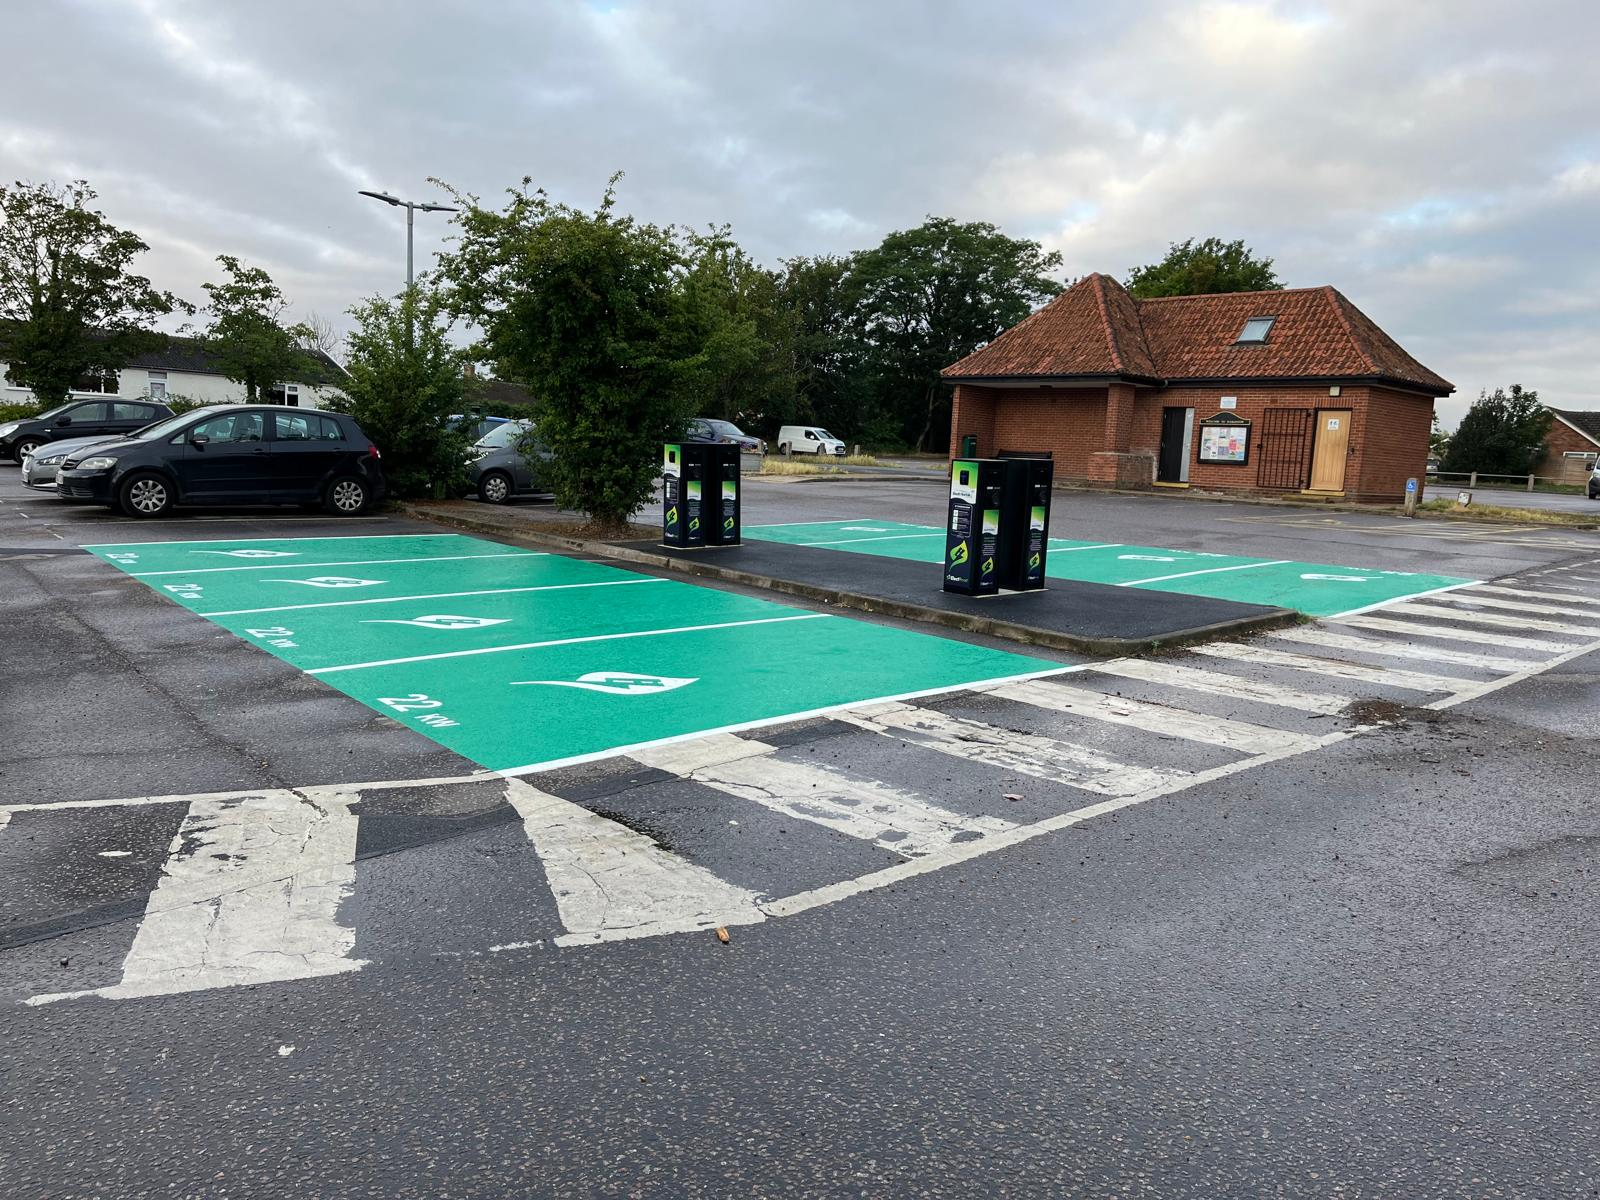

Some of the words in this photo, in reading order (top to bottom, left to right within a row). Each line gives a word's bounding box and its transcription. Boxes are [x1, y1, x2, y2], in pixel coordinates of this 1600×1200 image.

[245, 626, 294, 638] 22
[376, 693, 442, 712] 22
[414, 713, 460, 728] KW
